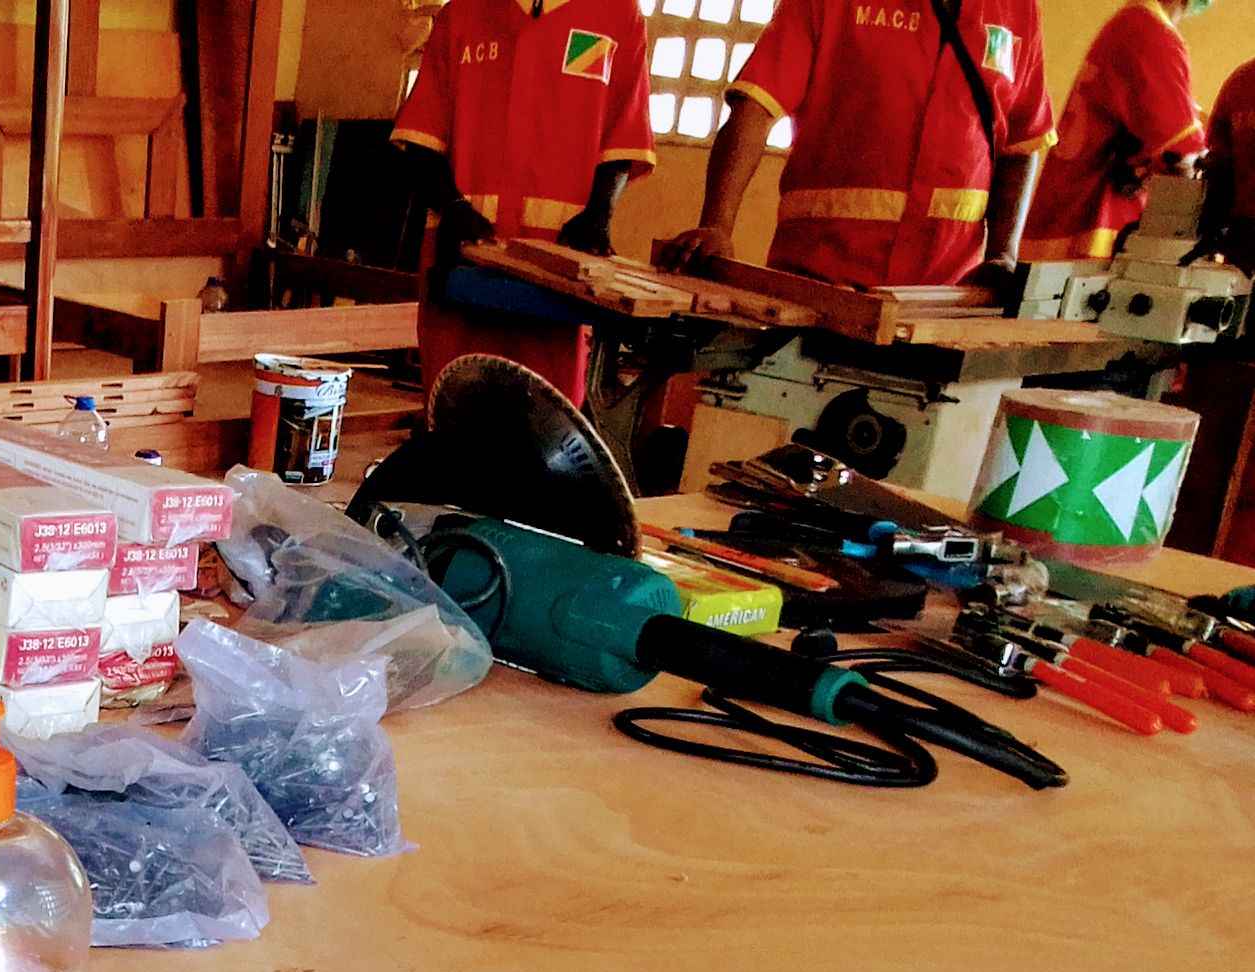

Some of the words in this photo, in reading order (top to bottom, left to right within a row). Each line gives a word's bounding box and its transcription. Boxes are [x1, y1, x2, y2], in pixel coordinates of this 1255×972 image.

[73, 522, 107, 535] E6013
[706, 607, 766, 629] AMERICAN
[57, 635, 90, 649] E6013
